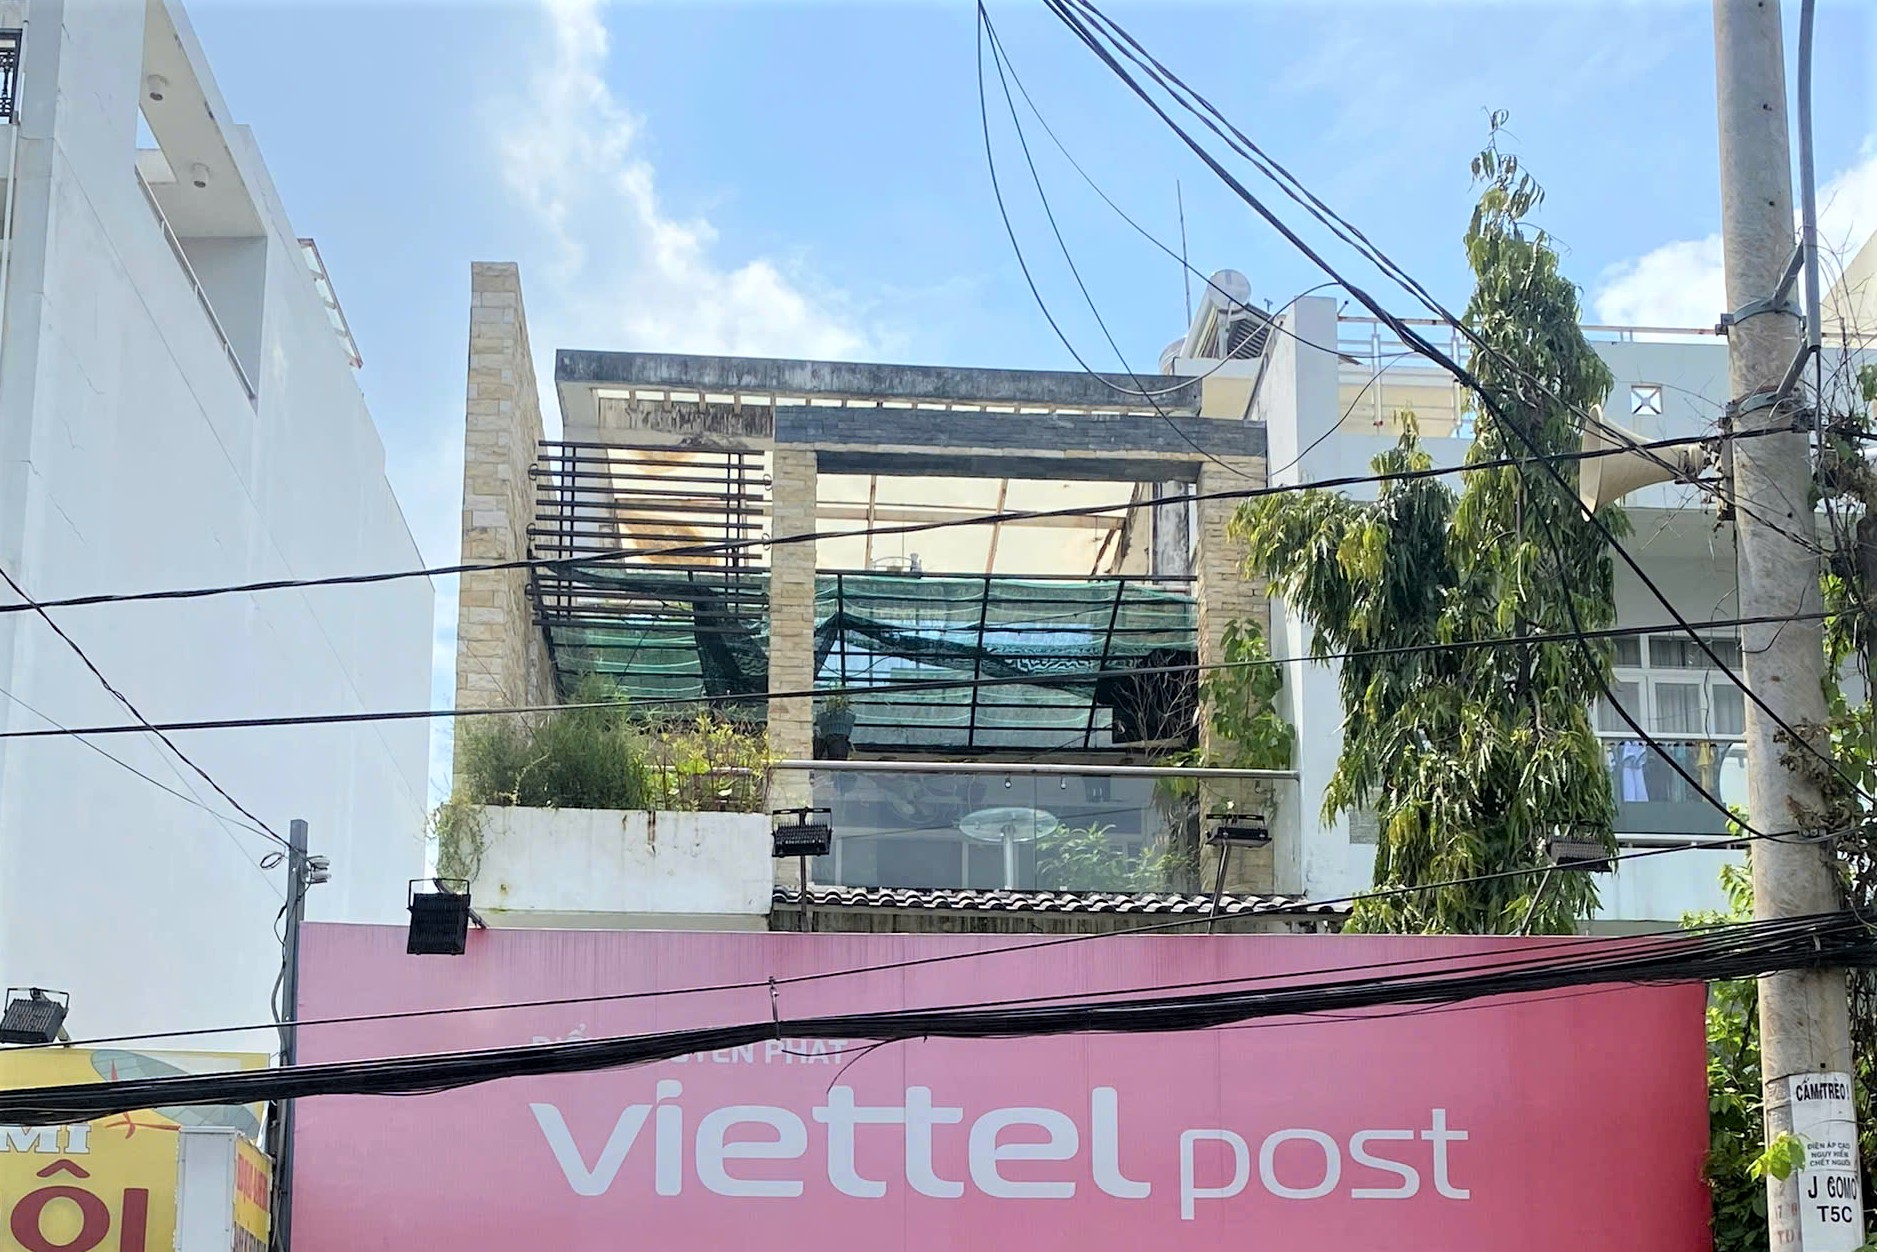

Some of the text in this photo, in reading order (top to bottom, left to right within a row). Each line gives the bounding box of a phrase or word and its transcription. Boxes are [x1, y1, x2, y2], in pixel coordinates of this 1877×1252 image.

[529, 1079, 1470, 1220] viettel post
[1817, 1205, 1852, 1223] T5C
